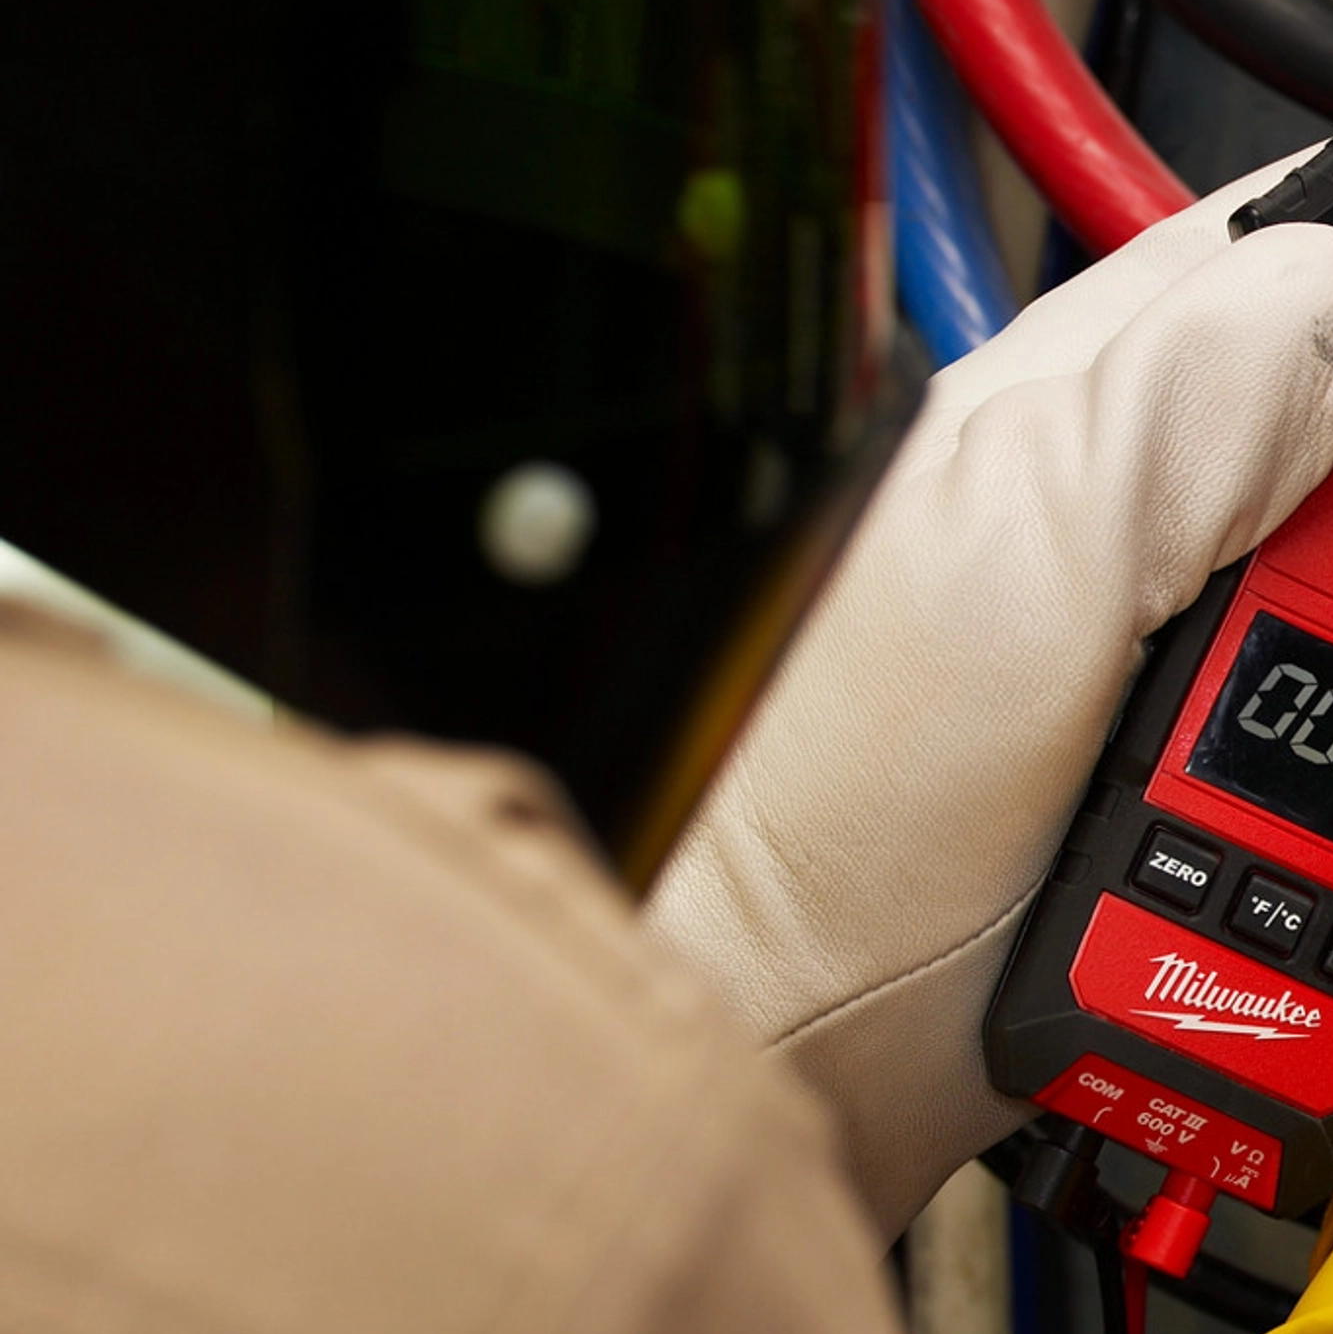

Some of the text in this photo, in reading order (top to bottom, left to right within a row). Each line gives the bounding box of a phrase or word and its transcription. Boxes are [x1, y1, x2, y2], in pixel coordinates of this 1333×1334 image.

[1149, 851, 1207, 887] ZERO
[1144, 951, 1322, 1029] Milwaukee
[1078, 1072, 1125, 1101] COM
[1136, 1109, 1196, 1144] 600 V
[1145, 1098, 1190, 1125] CAT
[1230, 1140, 1248, 1155] V
